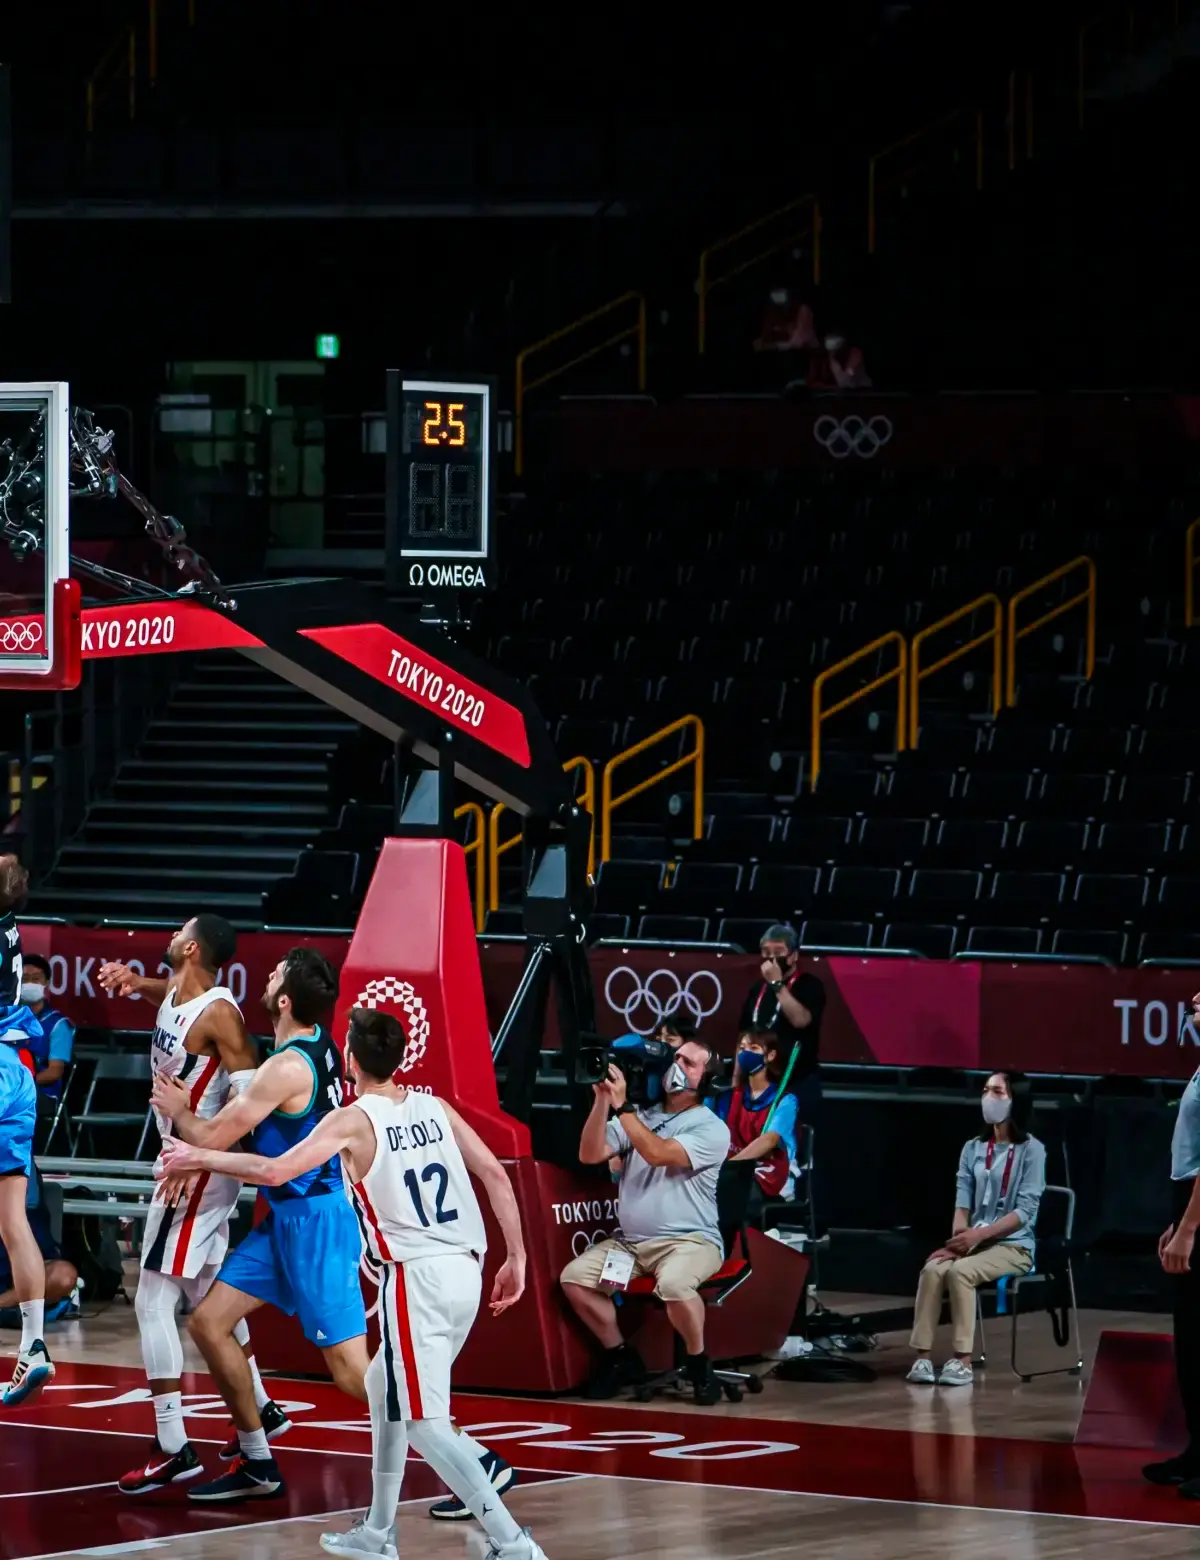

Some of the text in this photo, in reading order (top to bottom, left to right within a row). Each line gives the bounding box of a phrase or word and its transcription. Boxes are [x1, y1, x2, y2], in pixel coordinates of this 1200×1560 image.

[424, 402, 465, 446] 2.5
[427, 565, 487, 588] OMEGA
[81, 615, 175, 651] KYO 2020
[387, 648, 485, 727] TOKYO 2020
[386, 1125, 407, 1152] DE
[403, 1162, 459, 1228] 12
[551, 1201, 602, 1225] TOKYO
